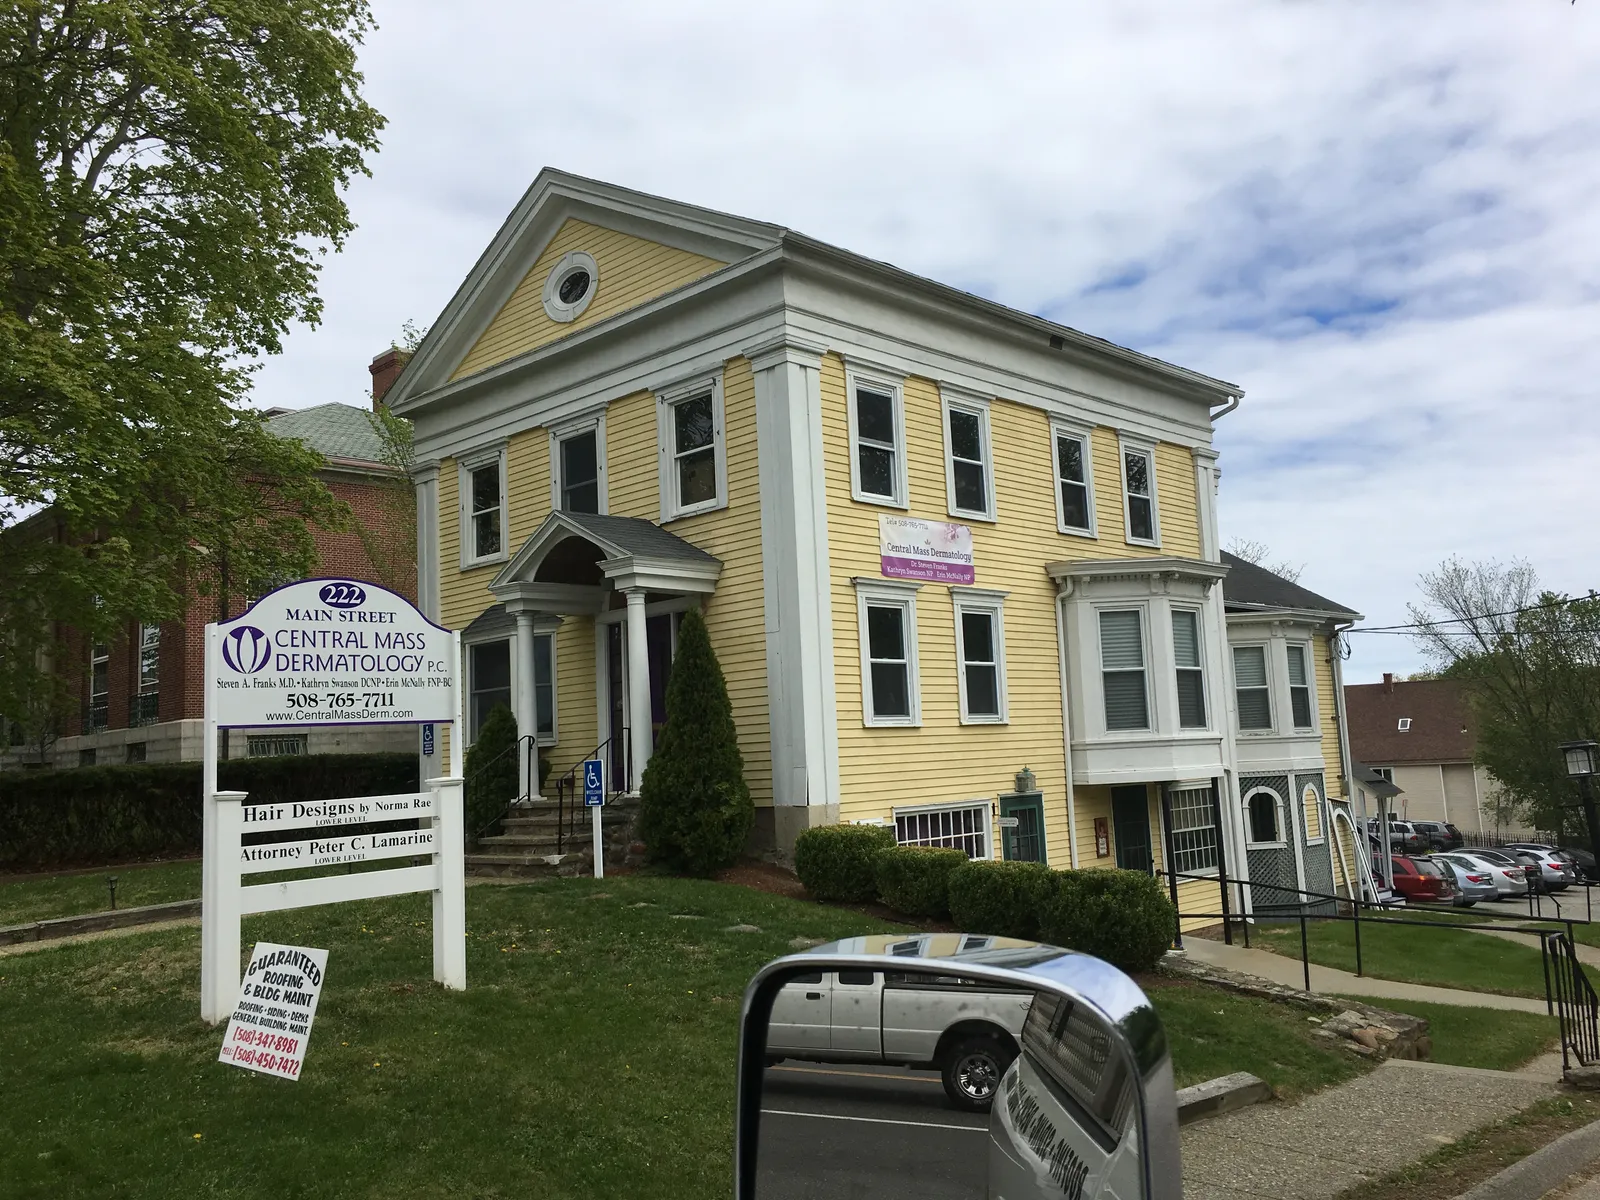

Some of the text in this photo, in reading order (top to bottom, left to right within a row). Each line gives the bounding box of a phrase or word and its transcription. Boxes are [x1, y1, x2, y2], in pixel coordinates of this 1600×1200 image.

[886, 542, 972, 563] Central Mass Dermatology
[886, 566, 906, 575] Kathryn
[906, 568, 926, 576] Swanson
[324, 585, 362, 604] 222
[285, 608, 397, 624] MAIN STREET
[275, 630, 426, 650] CENTRAL MASS
[276, 653, 448, 673] DERMATOLOGY P.C.
[216, 678, 240, 689] Steven
[242, 678, 250, 688] A.
[253, 678, 276, 688] Franks
[302, 678, 329, 690] Kathryn
[331, 678, 359, 688] Swanson
[386, 678, 399, 687] Erin
[401, 678, 425, 689] McNally
[427, 677, 452, 687] FNP-BC
[286, 692, 395, 708] 508-765-7711
[266, 709, 413, 721] www.CentralMassDerm.com
[243, 798, 432, 822] Hair Designs by Norma Rae
[315, 818, 342, 826] LOWER
[240, 832, 433, 862] Attorney Peter C. Lamarine
[314, 853, 367, 865] LOWER LEVEL
[248, 950, 321, 987] GUARANTEED
[244, 983, 251, 995] &
[263, 970, 304, 989] ROOFING
[232, 1011, 258, 1025] GENERAL
[259, 1016, 287, 1031] BUILDING
[238, 1001, 309, 1023] ROOFING SIDING DECKS
